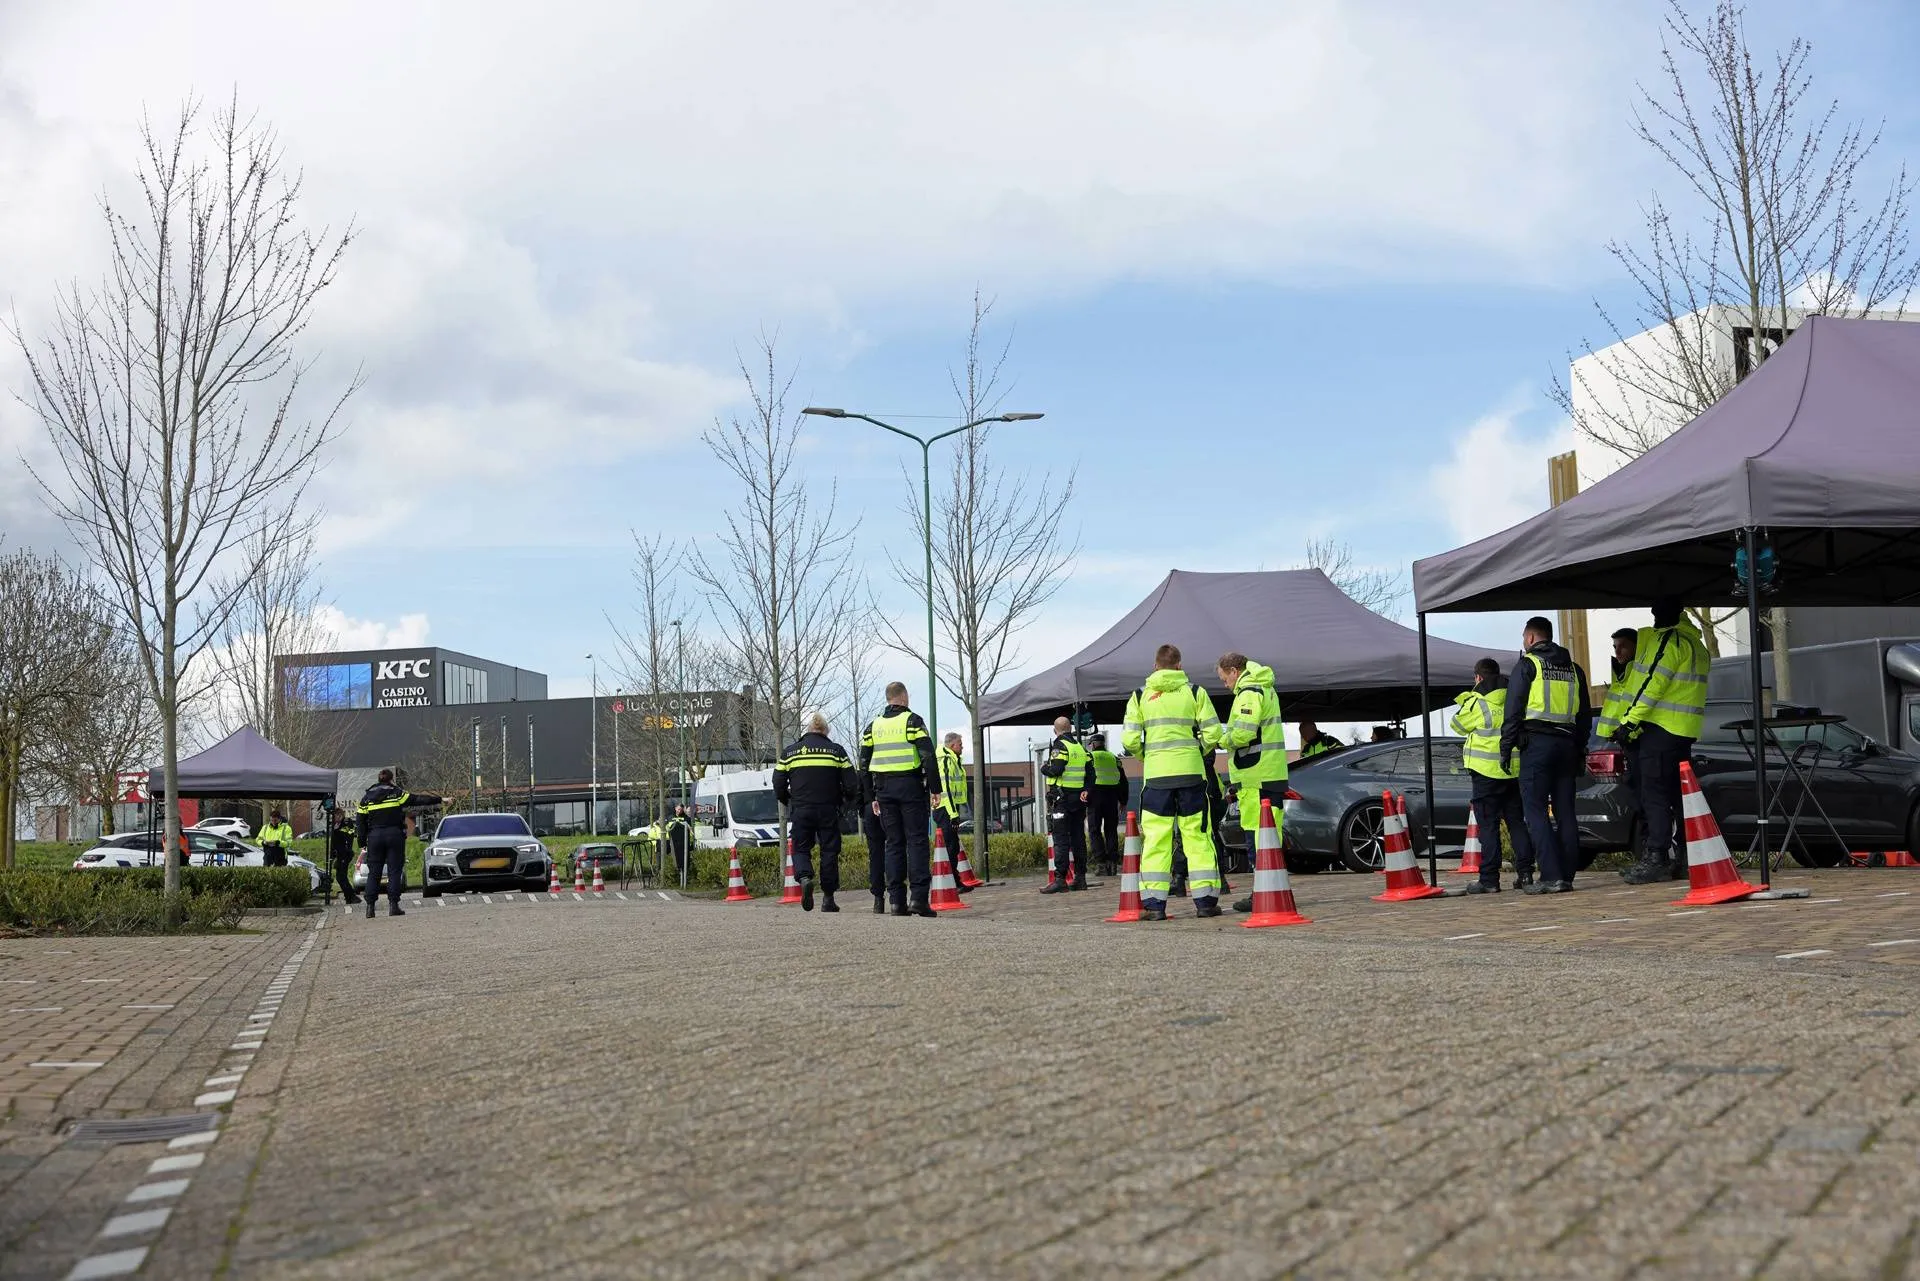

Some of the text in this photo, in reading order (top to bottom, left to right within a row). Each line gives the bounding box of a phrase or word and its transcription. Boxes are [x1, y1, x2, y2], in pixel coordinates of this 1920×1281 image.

[376, 659, 431, 680] KFC
[1543, 670, 1575, 682] CUSTOMS
[382, 687, 425, 697] CASINO
[377, 697, 431, 709] ADMIRAL
